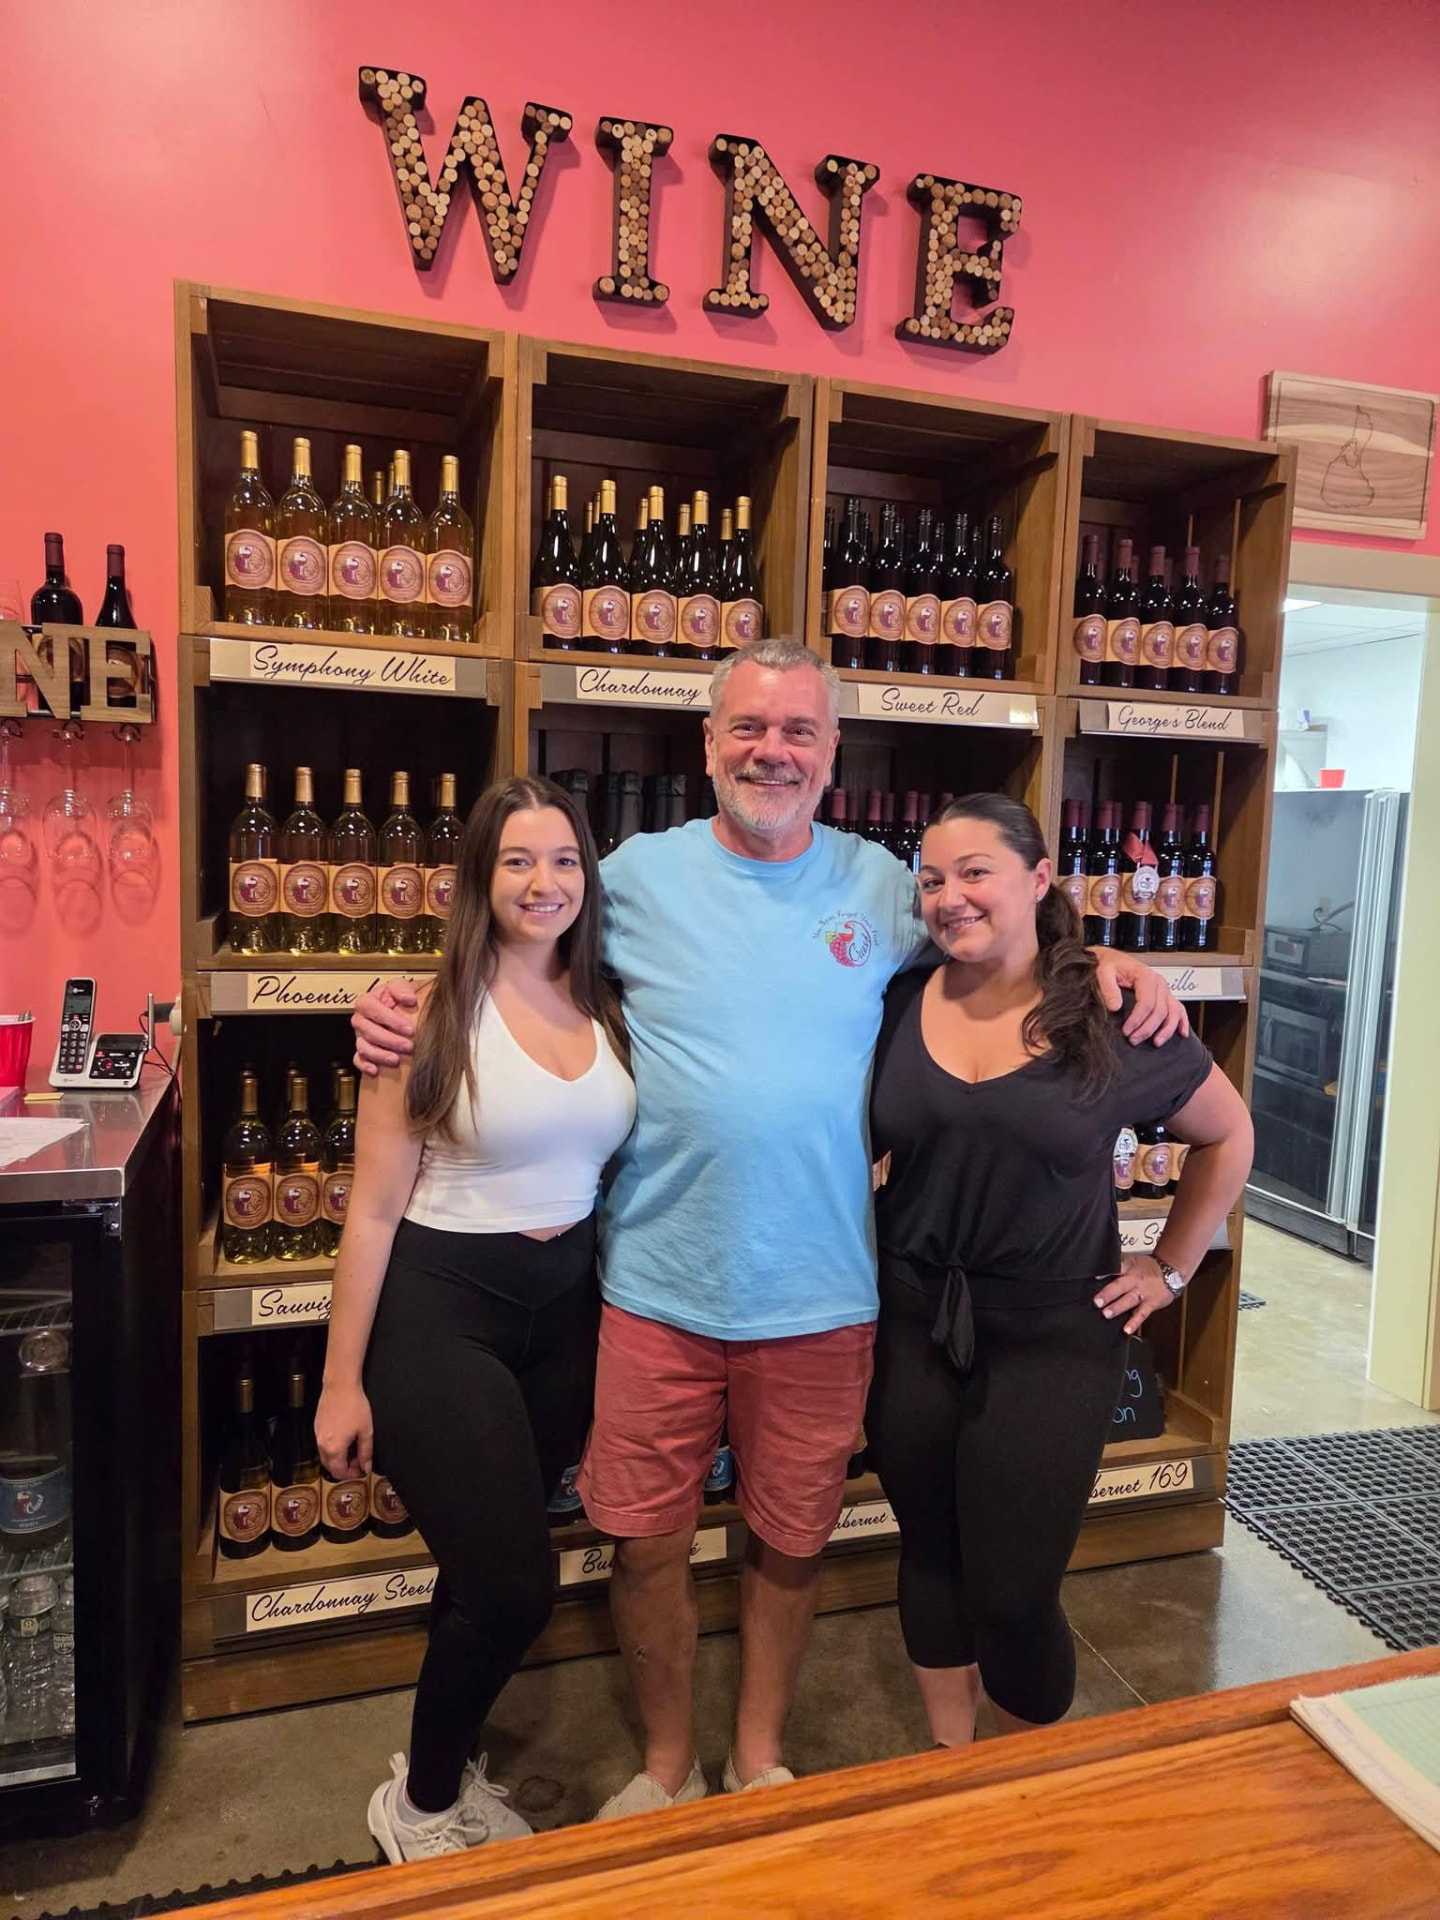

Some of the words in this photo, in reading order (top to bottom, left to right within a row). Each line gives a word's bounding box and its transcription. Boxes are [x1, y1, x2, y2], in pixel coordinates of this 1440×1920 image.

[359, 66, 1022, 354] WINE
[0, 619, 152, 723] NE
[253, 645, 376, 685] Symphony
[381, 655, 452, 686] White
[579, 669, 702, 706] Chardonnay
[881, 687, 938, 713] Sweet
[941, 691, 985, 717] Red
[1118, 704, 1181, 733] George's
[1184, 708, 1232, 730] Blend
[252, 975, 360, 1005] Phoenix
[1167, 969, 1198, 991] illo
[259, 1289, 332, 1321] Sauvig
[1090, 1473, 1143, 1498] bernet
[1149, 1462, 1188, 1491] 169
[834, 1508, 888, 1530] abernet
[251, 1586, 379, 1622] Chardonnay
[384, 1573, 434, 1601] Steel
